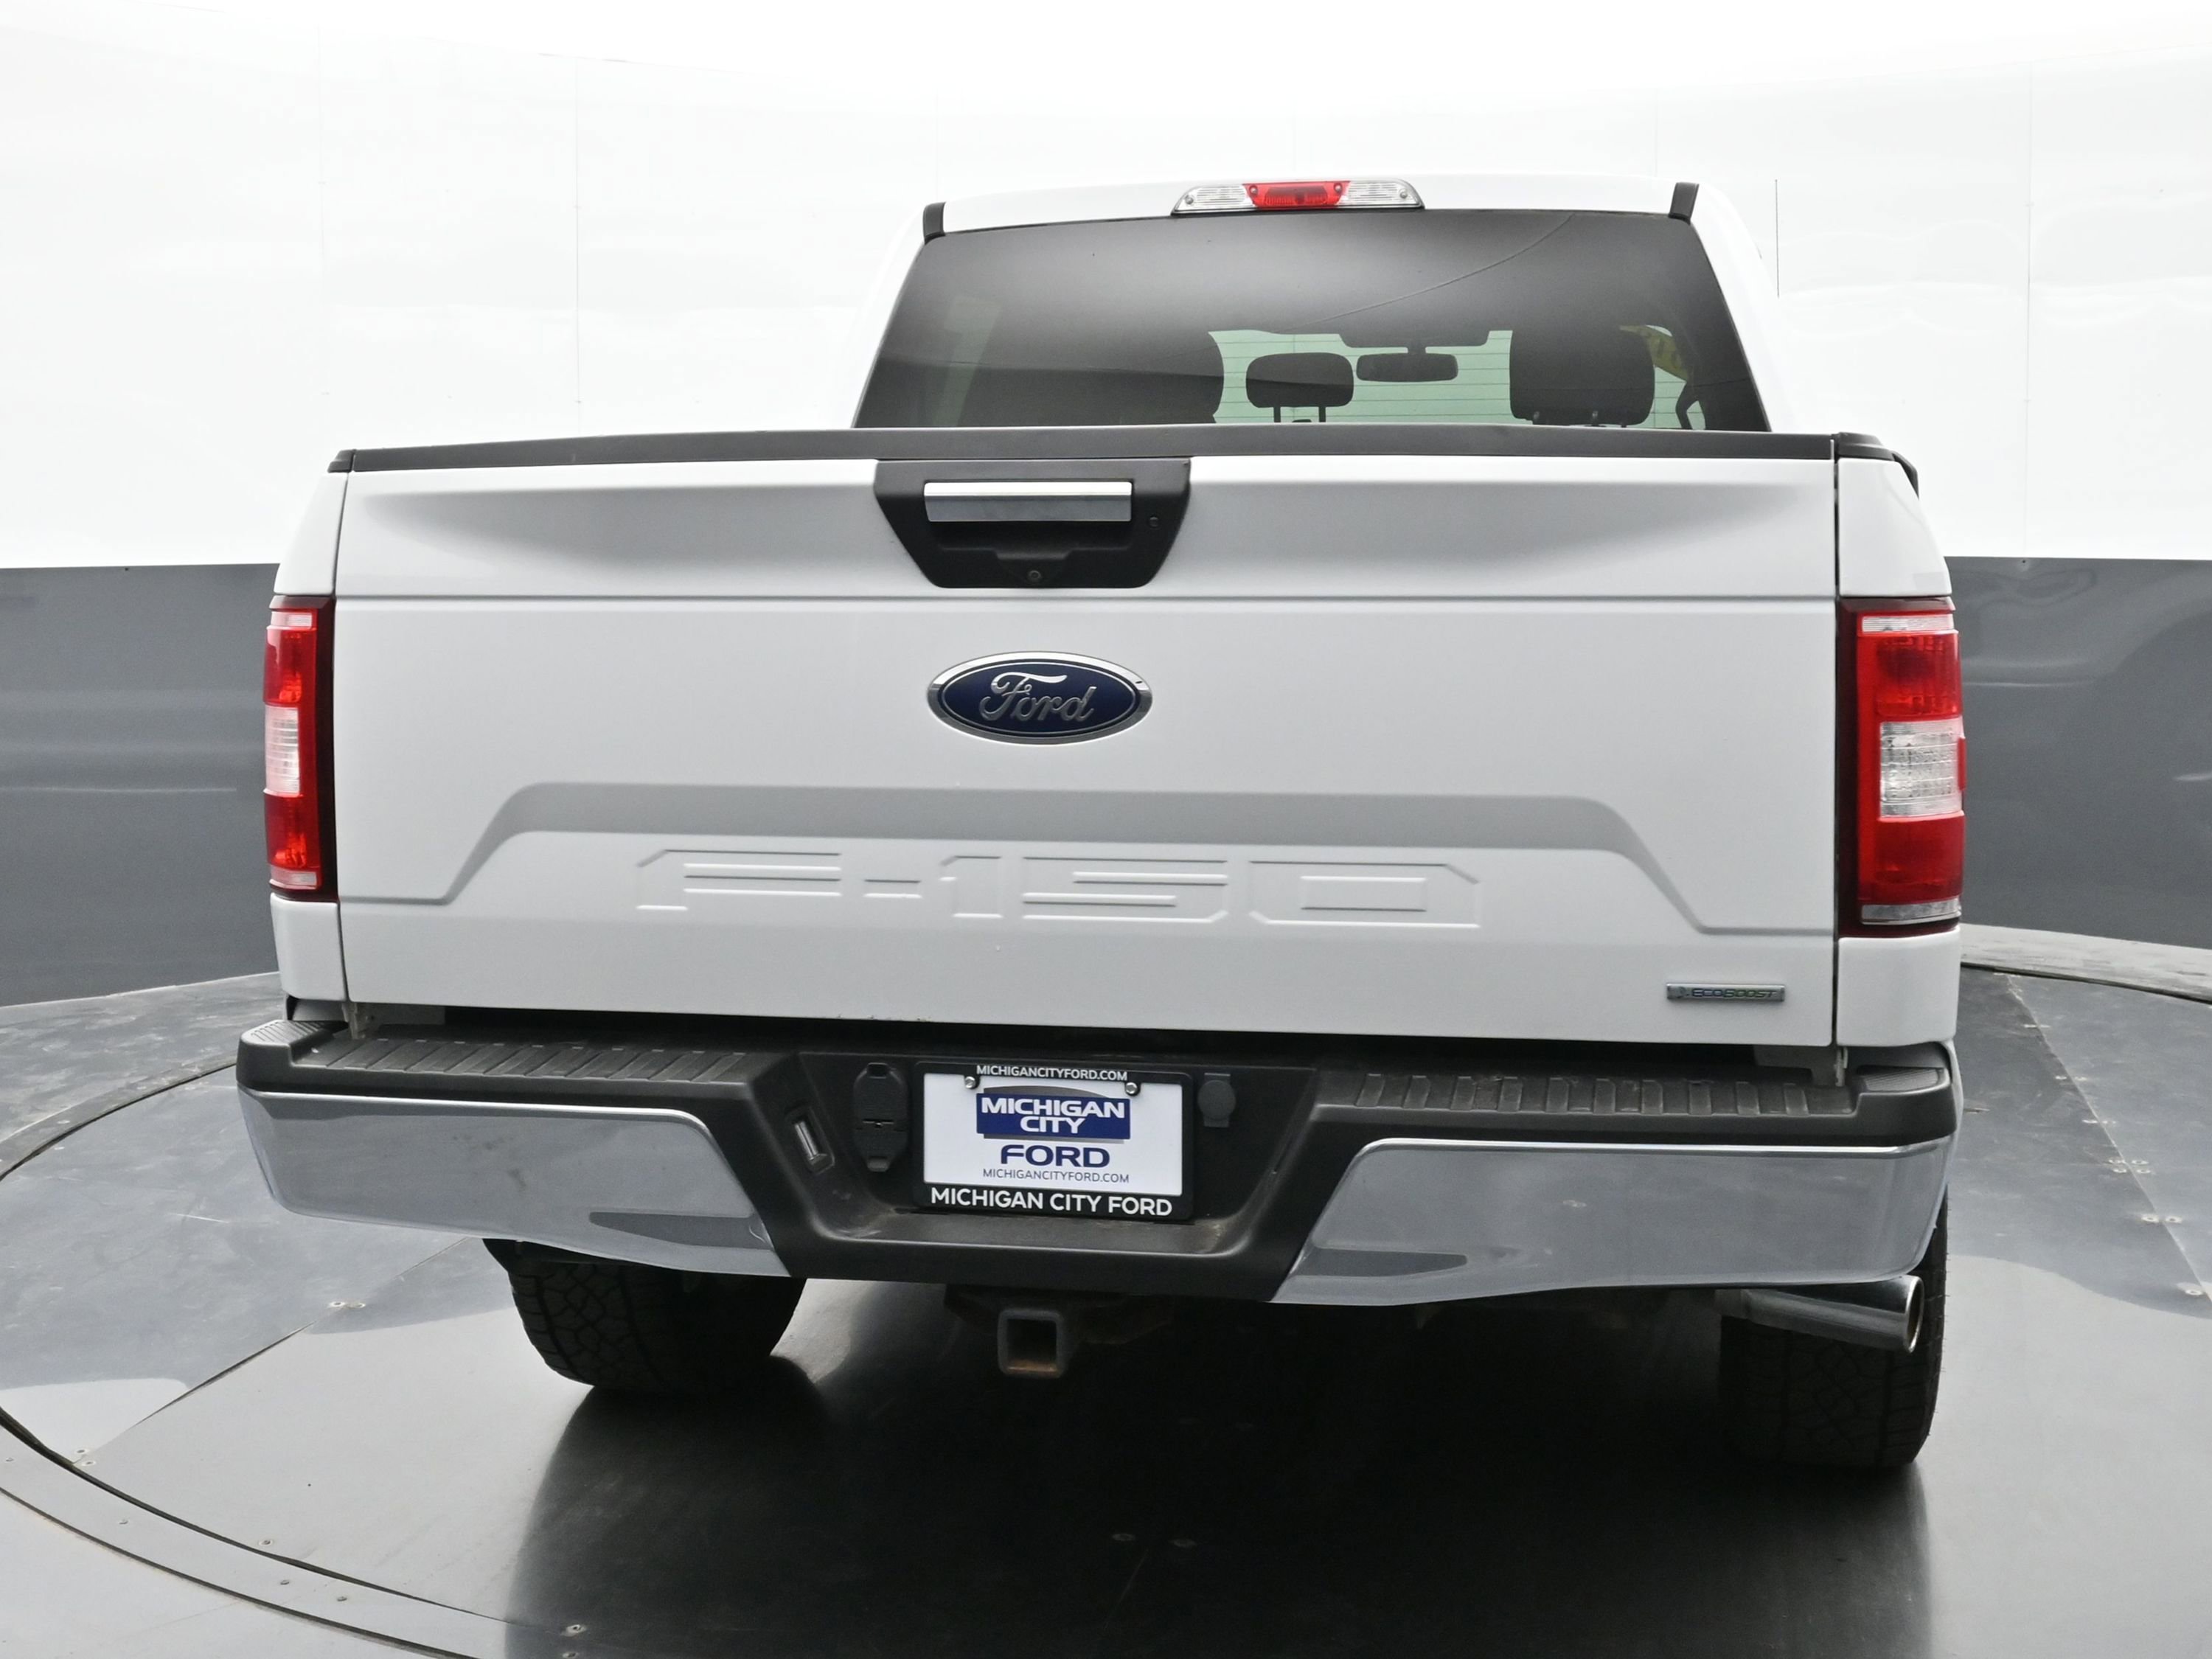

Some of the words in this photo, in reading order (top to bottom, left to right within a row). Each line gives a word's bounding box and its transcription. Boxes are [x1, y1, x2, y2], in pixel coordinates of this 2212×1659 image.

[979, 672, 1097, 722] Ford
[977, 1065, 1127, 1081] MICHIGANCITYFORD.COM
[981, 1098, 1124, 1118] MICHIGAN
[1020, 1116, 1085, 1133] CITY
[1001, 1144, 1110, 1167] FORD
[983, 1168, 1130, 1183] MICHIGANCITYFORD.COM
[931, 1187, 1043, 1209] MICHIGAN
[1050, 1196, 1102, 1213] CITY
[1108, 1198, 1172, 1217] FORD
